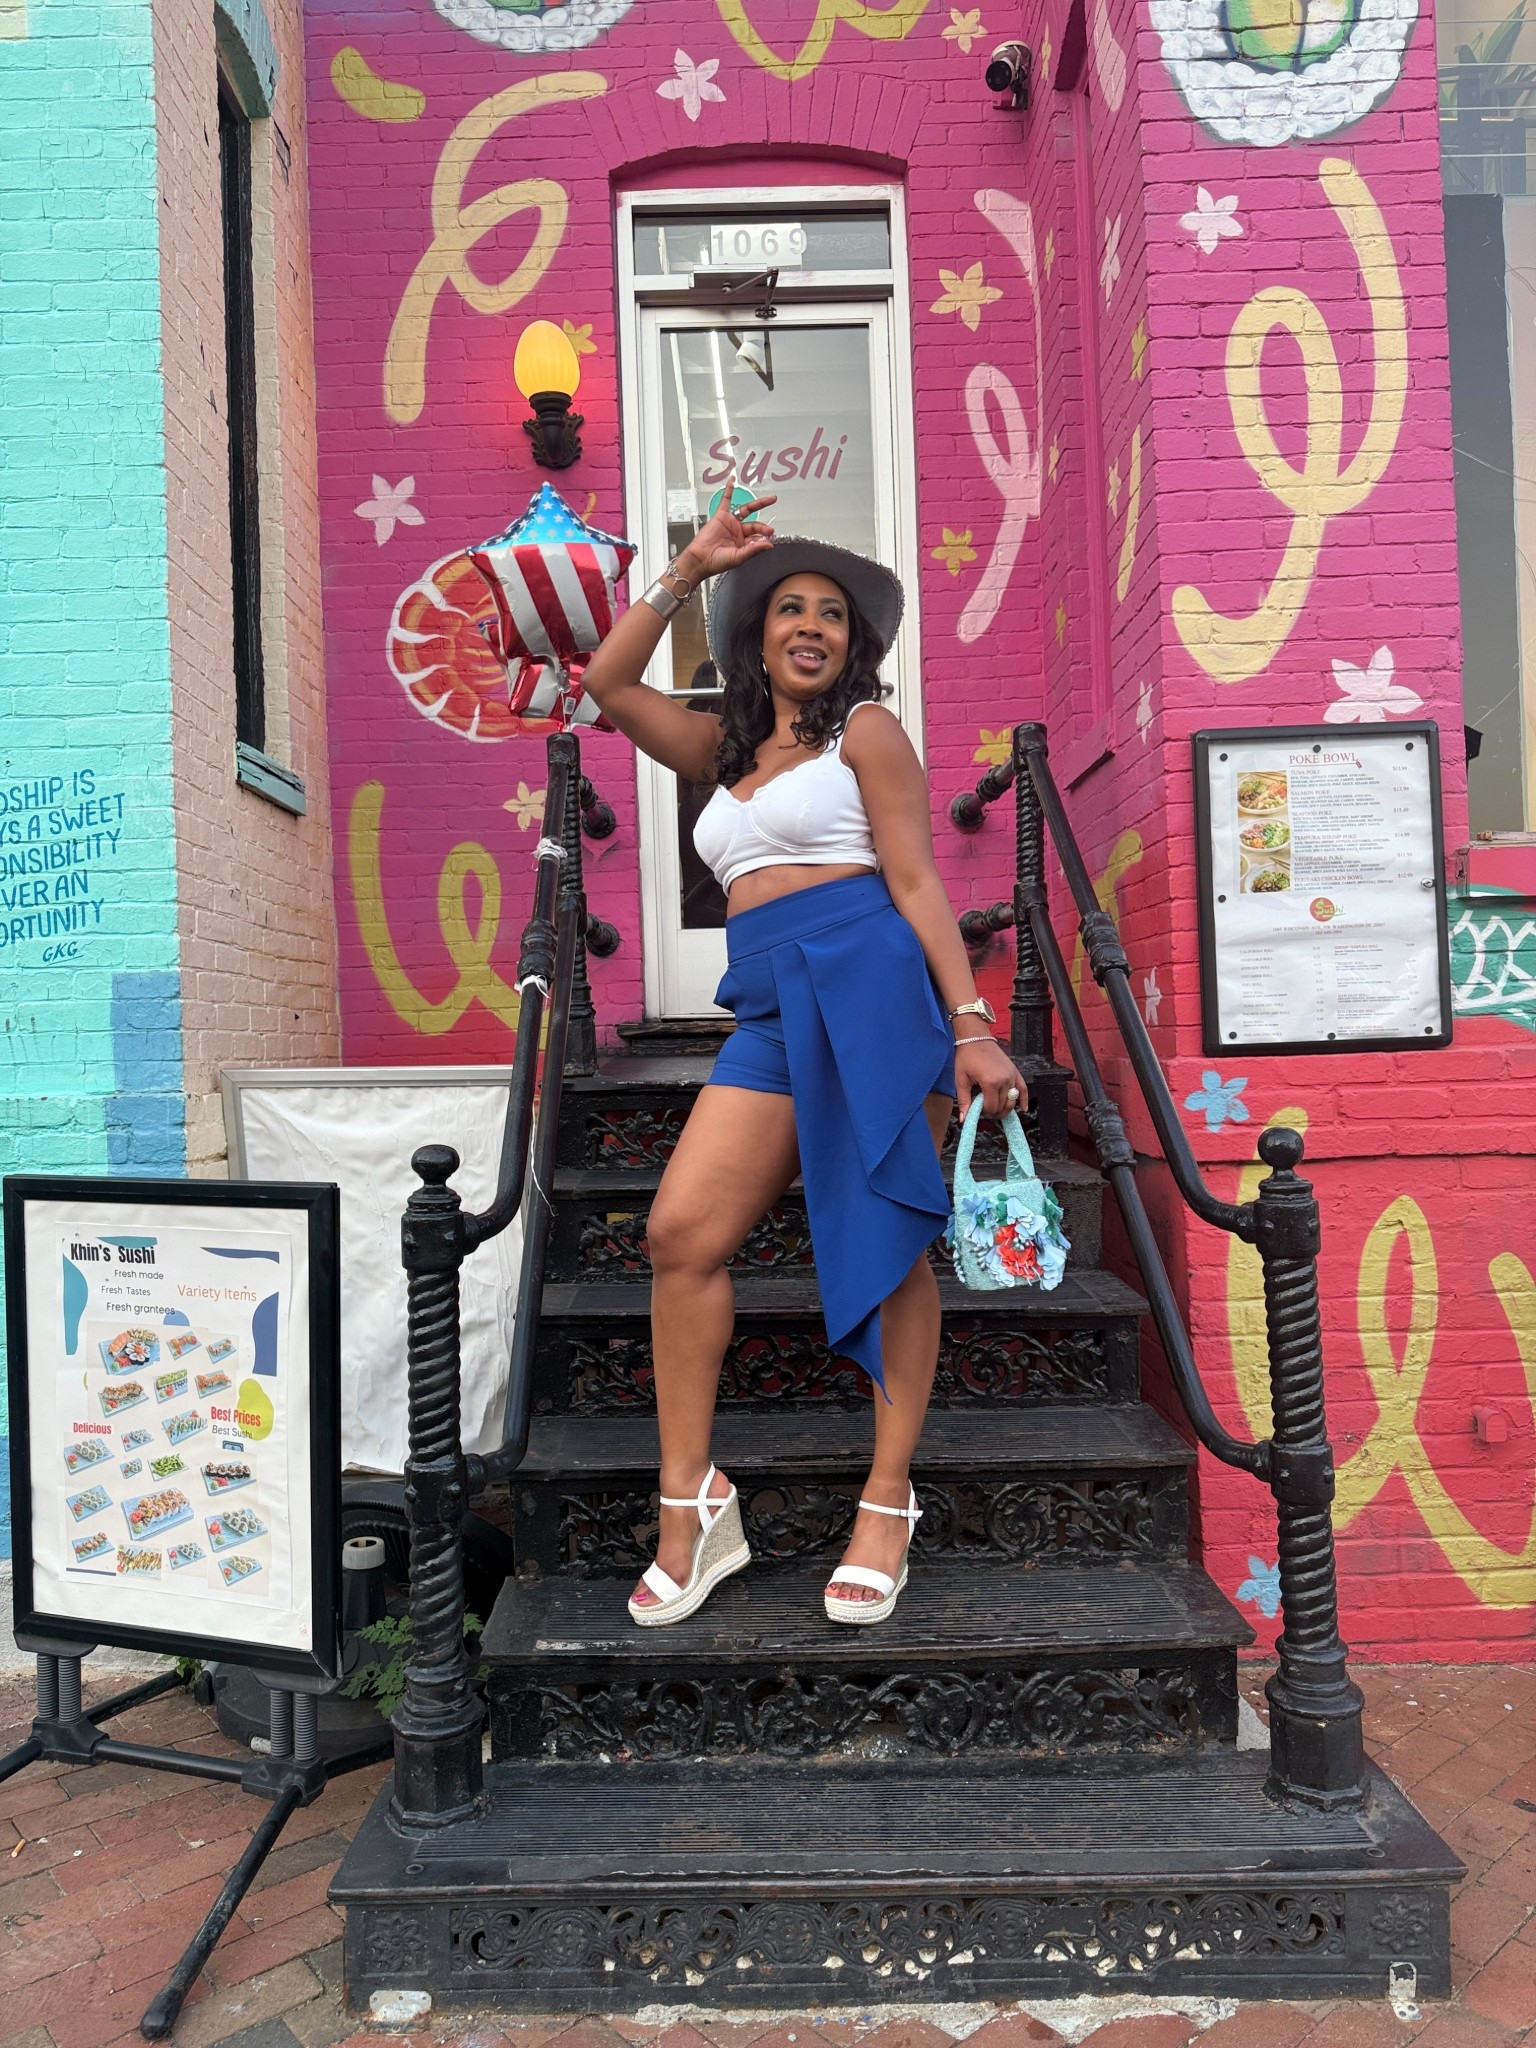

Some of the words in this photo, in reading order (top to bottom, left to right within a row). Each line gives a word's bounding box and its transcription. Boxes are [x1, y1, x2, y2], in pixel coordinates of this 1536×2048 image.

[712, 228, 807, 257] 1069
[703, 427, 848, 484] Sushi
[1289, 754, 1320, 764] POKE
[1323, 752, 1359, 763] BOWL
[74, 768, 96, 796] IS
[28, 814, 41, 840] A
[48, 792, 126, 835] SWEET
[1, 879, 50, 911] VER
[55, 869, 89, 902] AN
[42, 941, 79, 963] GKG
[70, 1242, 111, 1262] Khin's
[118, 1245, 156, 1264] Sushi
[114, 1269, 137, 1279] Fresh
[138, 1270, 164, 1280] made
[101, 1285, 123, 1294] Fresh
[126, 1286, 151, 1296] Tastes
[177, 1284, 221, 1302] Variety
[224, 1287, 257, 1302] Items
[106, 1301, 132, 1312] Fresh
[134, 1303, 176, 1316] grantees
[210, 1406, 231, 1421] Best
[233, 1409, 261, 1428] Prices
[73, 1422, 112, 1435] Delicious
[212, 1424, 230, 1435] Best
[231, 1427, 253, 1440] Sushi
